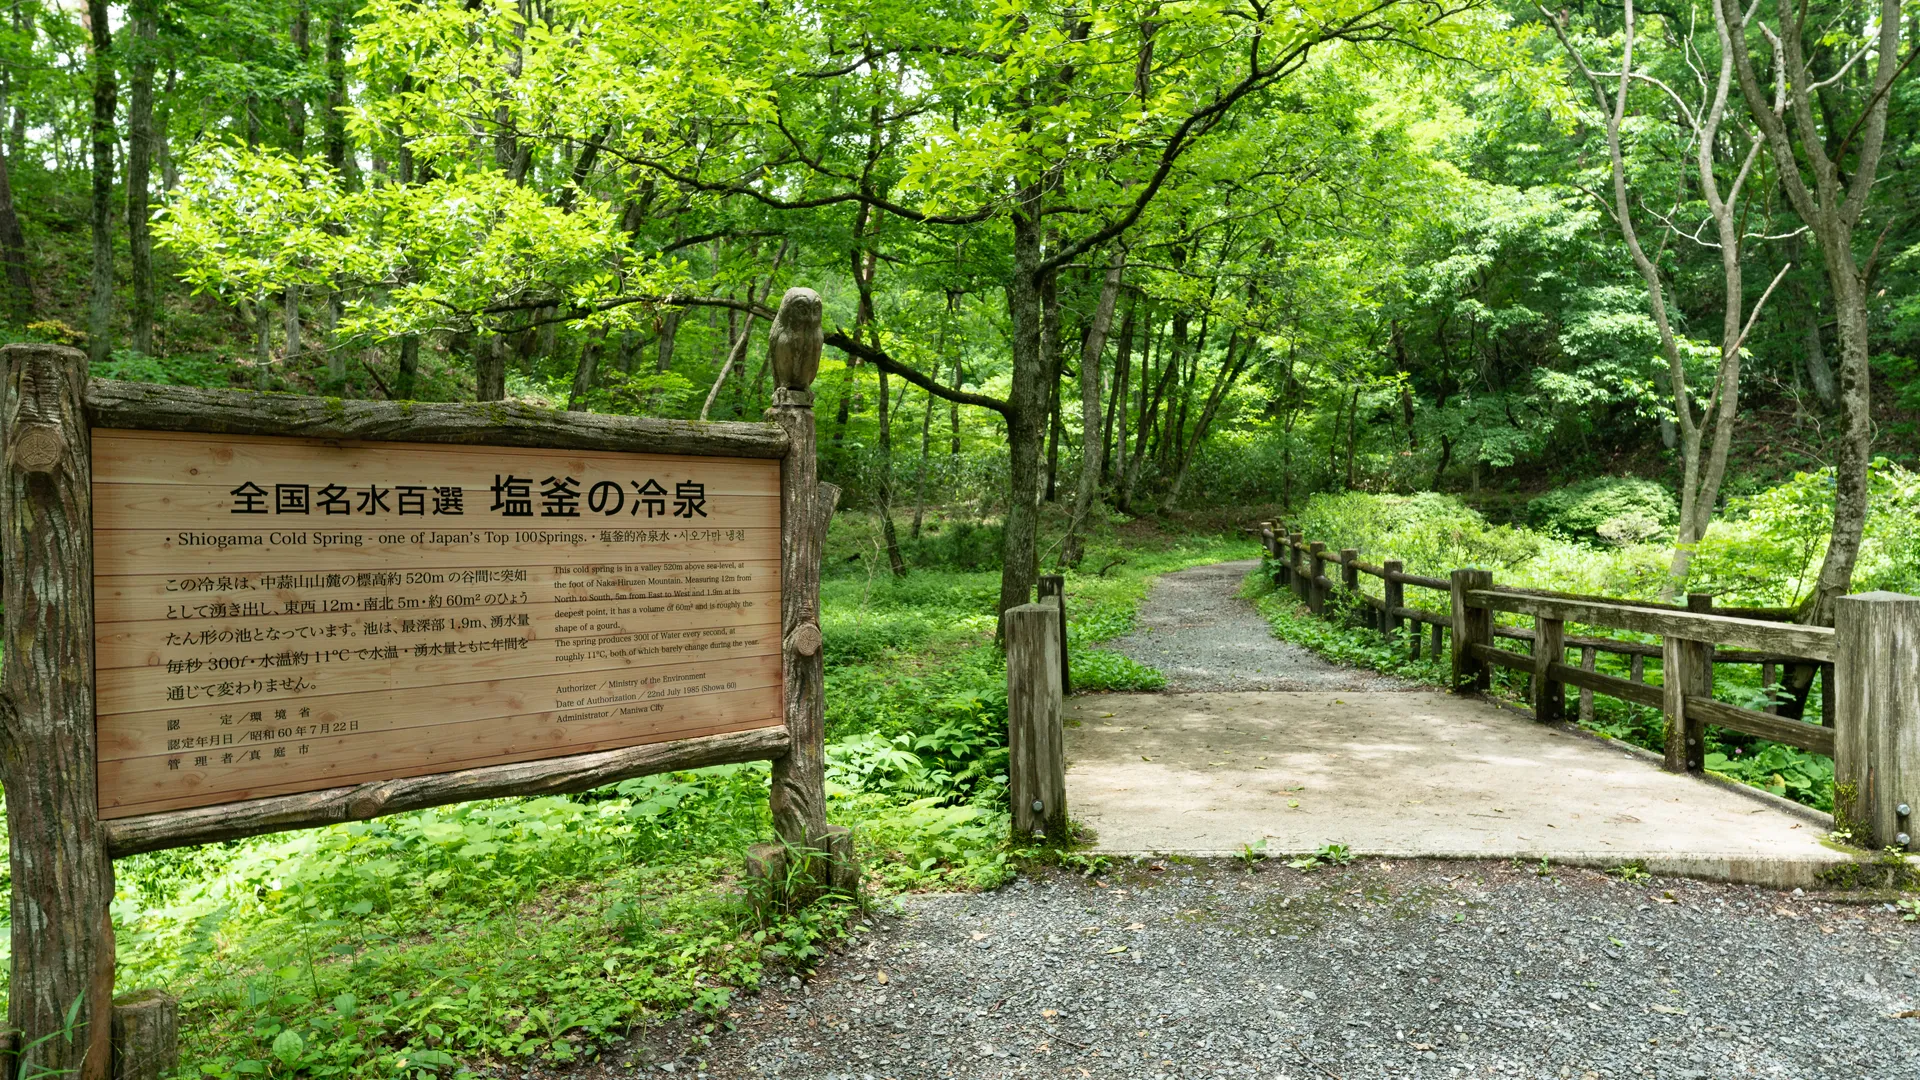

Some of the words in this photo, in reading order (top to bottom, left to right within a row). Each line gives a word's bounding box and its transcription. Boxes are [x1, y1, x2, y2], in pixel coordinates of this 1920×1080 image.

[229, 480, 465, 515] 全国名水百選
[490, 474, 708, 519] 塩釜の冷泉
[178, 532, 263, 548] Shiogama
[269, 532, 307, 545] Cold
[313, 532, 362, 547] Spring
[379, 534, 405, 544] one
[411, 532, 425, 544] of
[484, 532, 509, 545] Top
[600, 530, 670, 543] 塩釜的冷泉水
[406, 572, 444, 584] 520m
[449, 569, 527, 584] の谷間に突如
[554, 566, 570, 574] This
[592, 565, 614, 574] spring
[641, 564, 662, 572] valley
[685, 563, 705, 571] above
[569, 580, 584, 588] foot
[648, 577, 683, 585] Mountain.
[484, 591, 528, 604] のひょう
[555, 595, 576, 603] North
[555, 610, 584, 618] deepest
[587, 609, 608, 617] point,
[717, 601, 740, 609] roughly
[555, 625, 577, 633] shape
[597, 622, 620, 631] gourd.
[573, 638, 596, 647] spring
[598, 635, 631, 645] produces
[661, 631, 680, 639] Water
[703, 628, 727, 636] second,
[555, 653, 584, 662] roughly
[638, 647, 659, 655] which
[662, 645, 682, 653] barely
[710, 641, 731, 649] during
[166, 658, 202, 674] 毎秒
[167, 677, 317, 701] 通じて変わりません。
[556, 684, 597, 694] Authorizer
[608, 679, 638, 688] Ministry
[663, 673, 706, 682] Environment
[556, 700, 574, 708] Date
[587, 693, 636, 705] Authorization
[647, 690, 665, 698] 22nd
[667, 688, 681, 696] July
[684, 686, 699, 694] 1985
[702, 684, 724, 692] (Showa
[556, 711, 609, 723] Administrator
[620, 706, 648, 715] Maniwa
[650, 703, 664, 712] City
